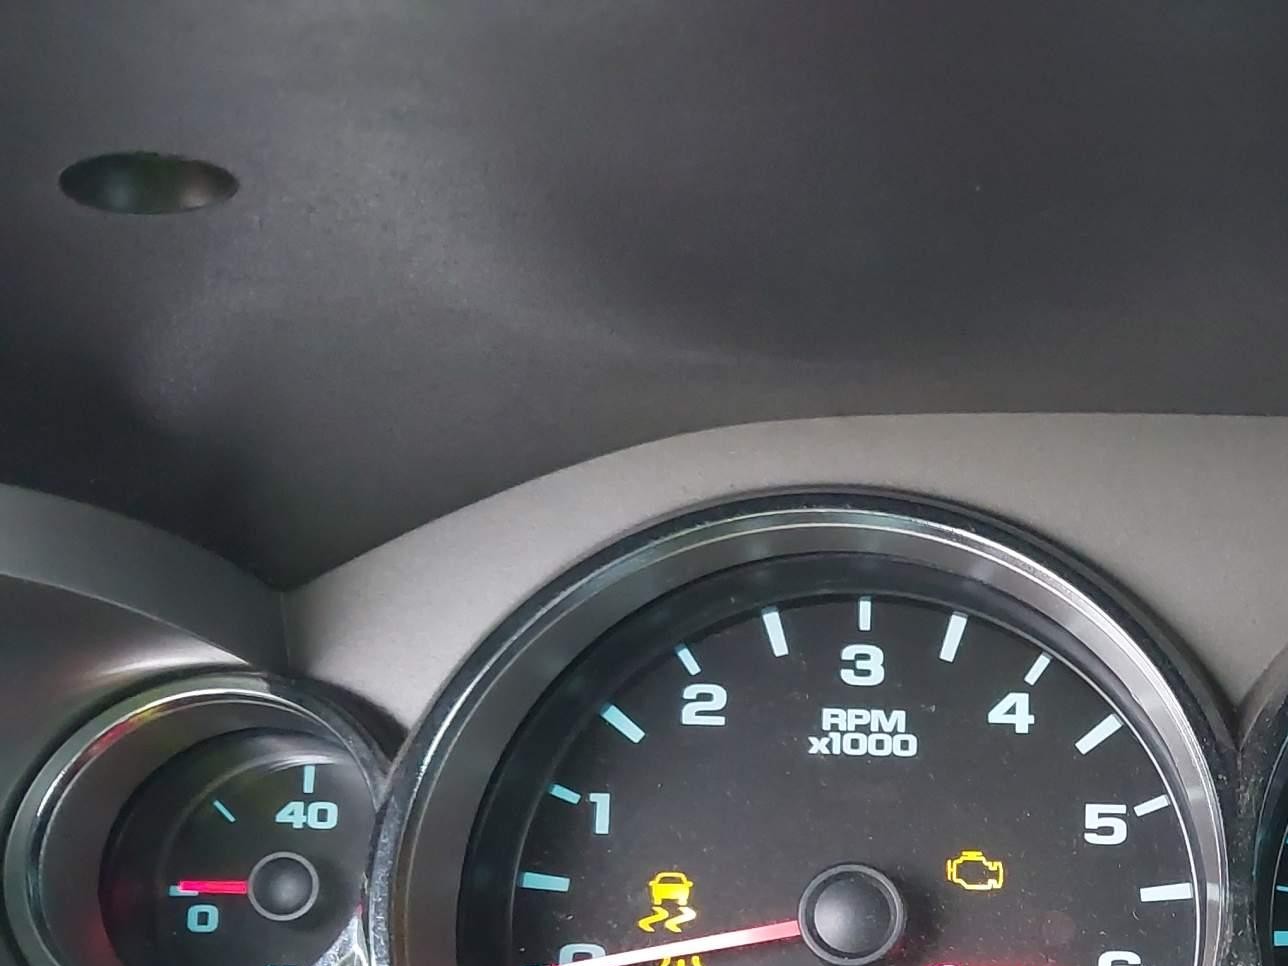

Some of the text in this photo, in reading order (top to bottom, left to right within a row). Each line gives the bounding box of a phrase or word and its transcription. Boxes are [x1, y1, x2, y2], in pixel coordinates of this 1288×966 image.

[841, 644, 885, 686] 3
[681, 684, 727, 726] 2
[822, 709, 906, 733] RPM
[988, 692, 1035, 733] 4
[809, 732, 917, 758] x1000
[275, 801, 338, 830] 40
[590, 793, 610, 835] 1
[1085, 803, 1128, 846] 5
[187, 905, 219, 933] 0
